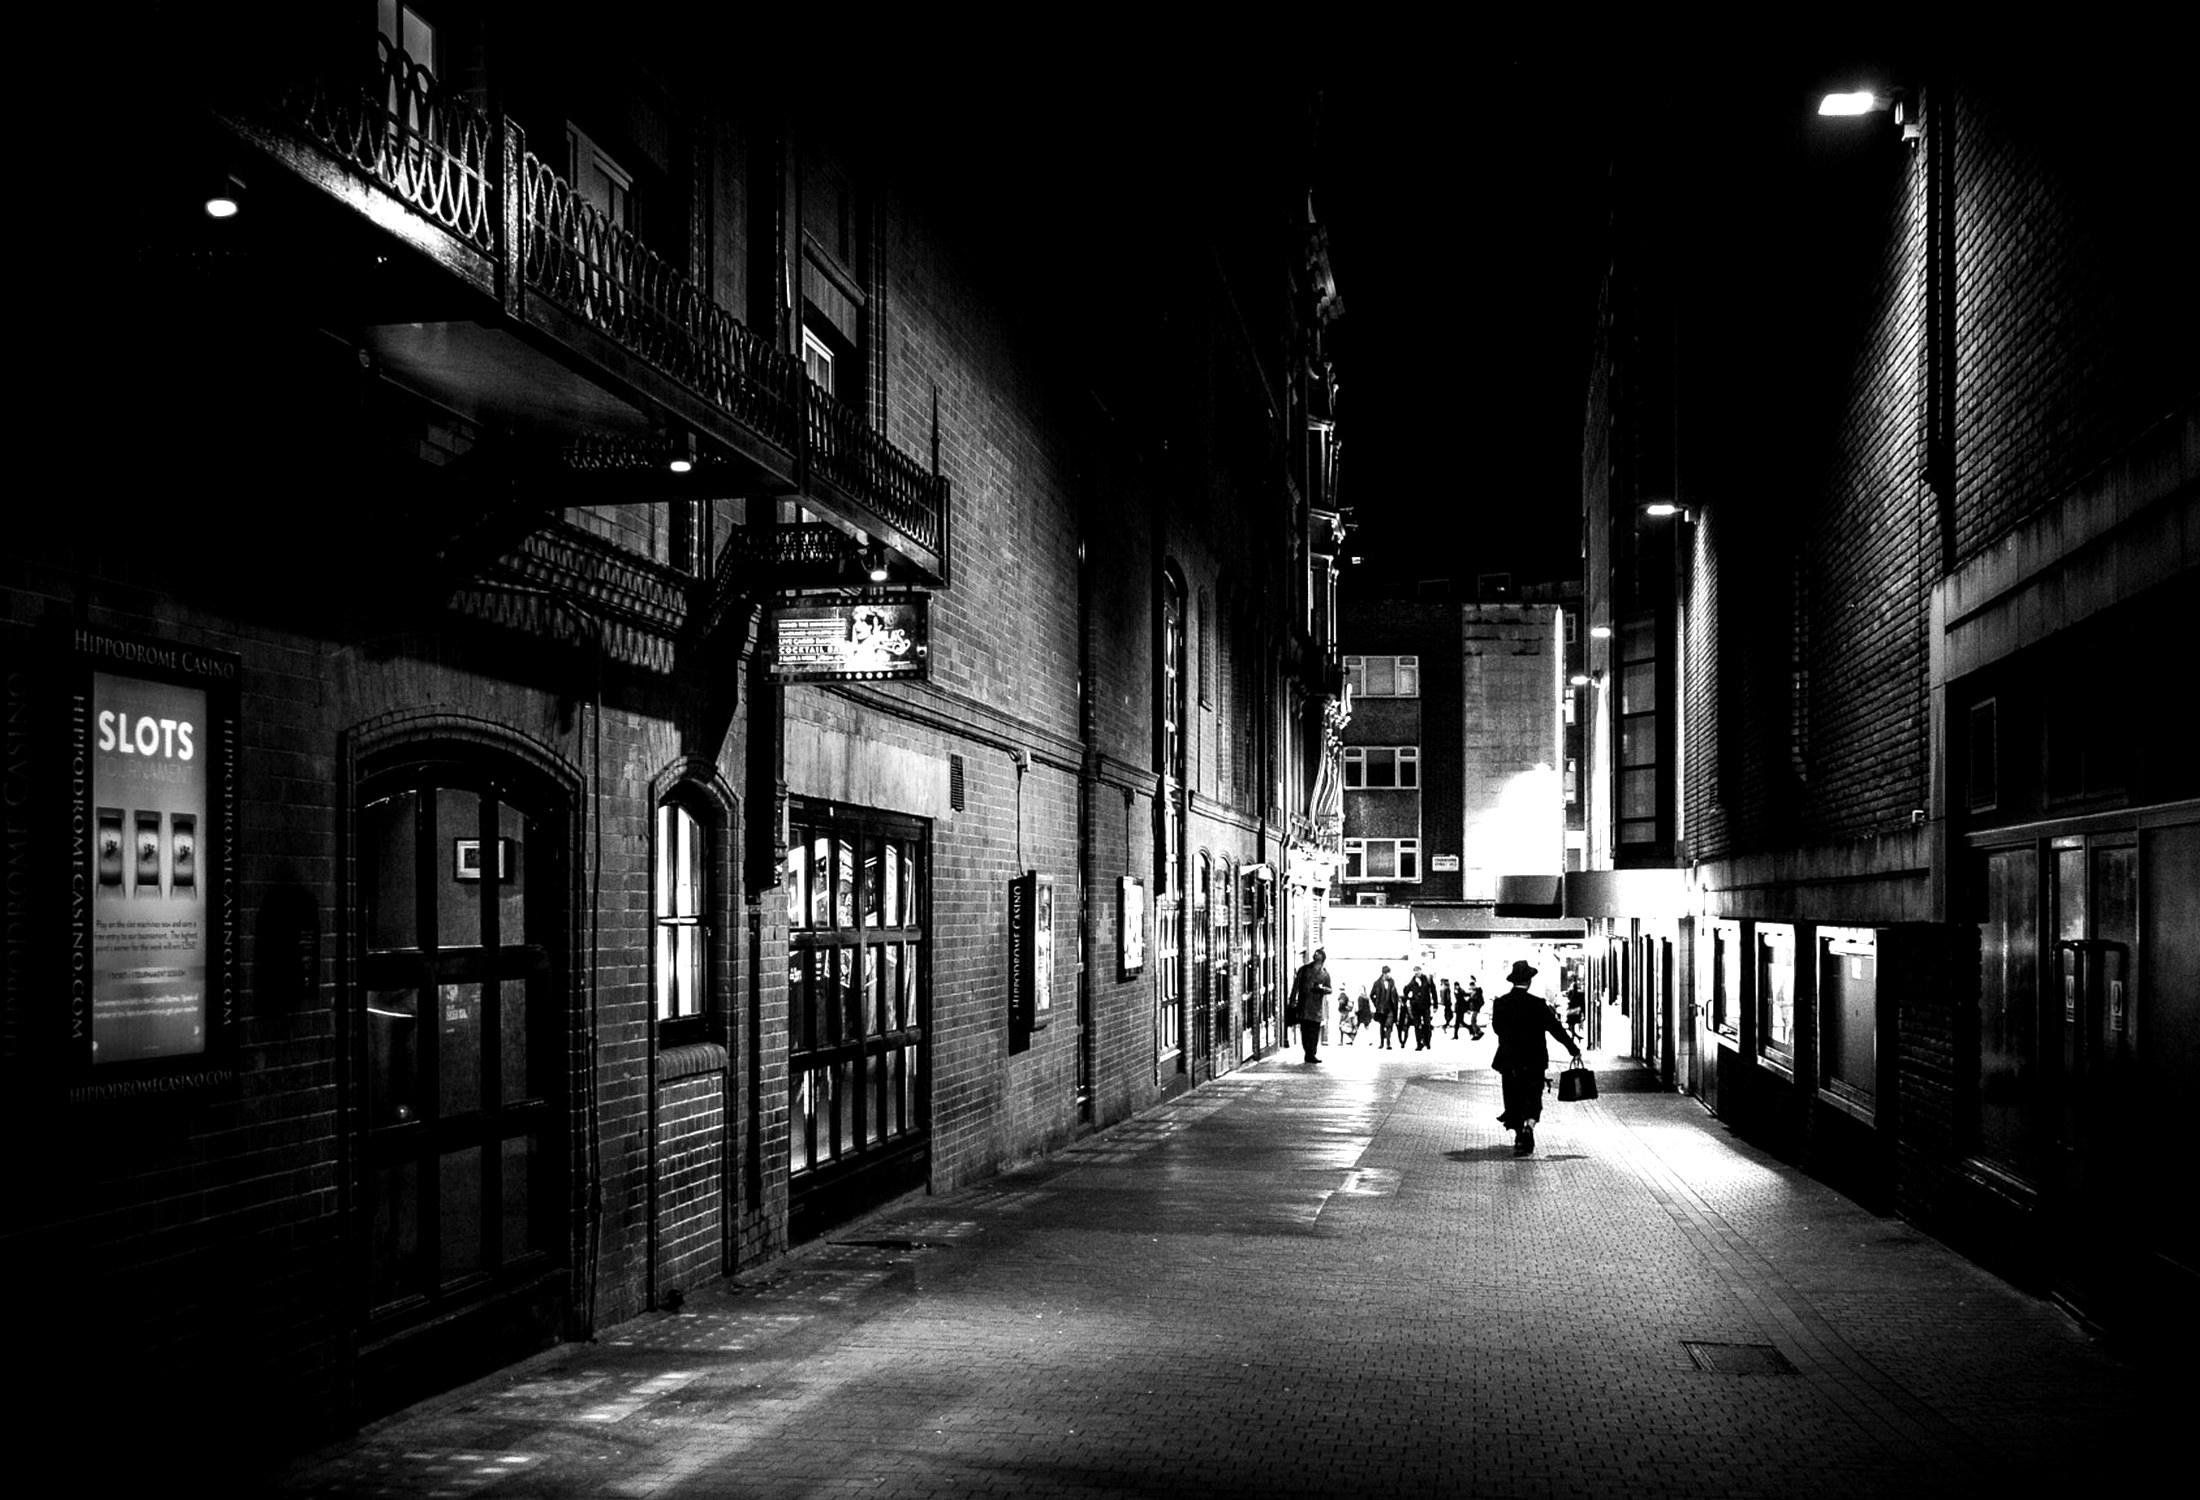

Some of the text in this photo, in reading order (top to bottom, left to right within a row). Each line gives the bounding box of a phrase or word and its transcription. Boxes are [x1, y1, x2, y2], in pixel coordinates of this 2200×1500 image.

[74, 628, 235, 680] HIPPODROME CASINO
[779, 646, 825, 654] COCKTAIL
[98, 709, 195, 761] SLOTS
[71, 694, 86, 1040] HIPPODROMECASINO.COM
[222, 719, 235, 1027] HIPPODROMECASINO.COM
[1012, 885, 1022, 930] CASINO
[69, 1068, 234, 1105] HIPPODROMECASINO.COM
